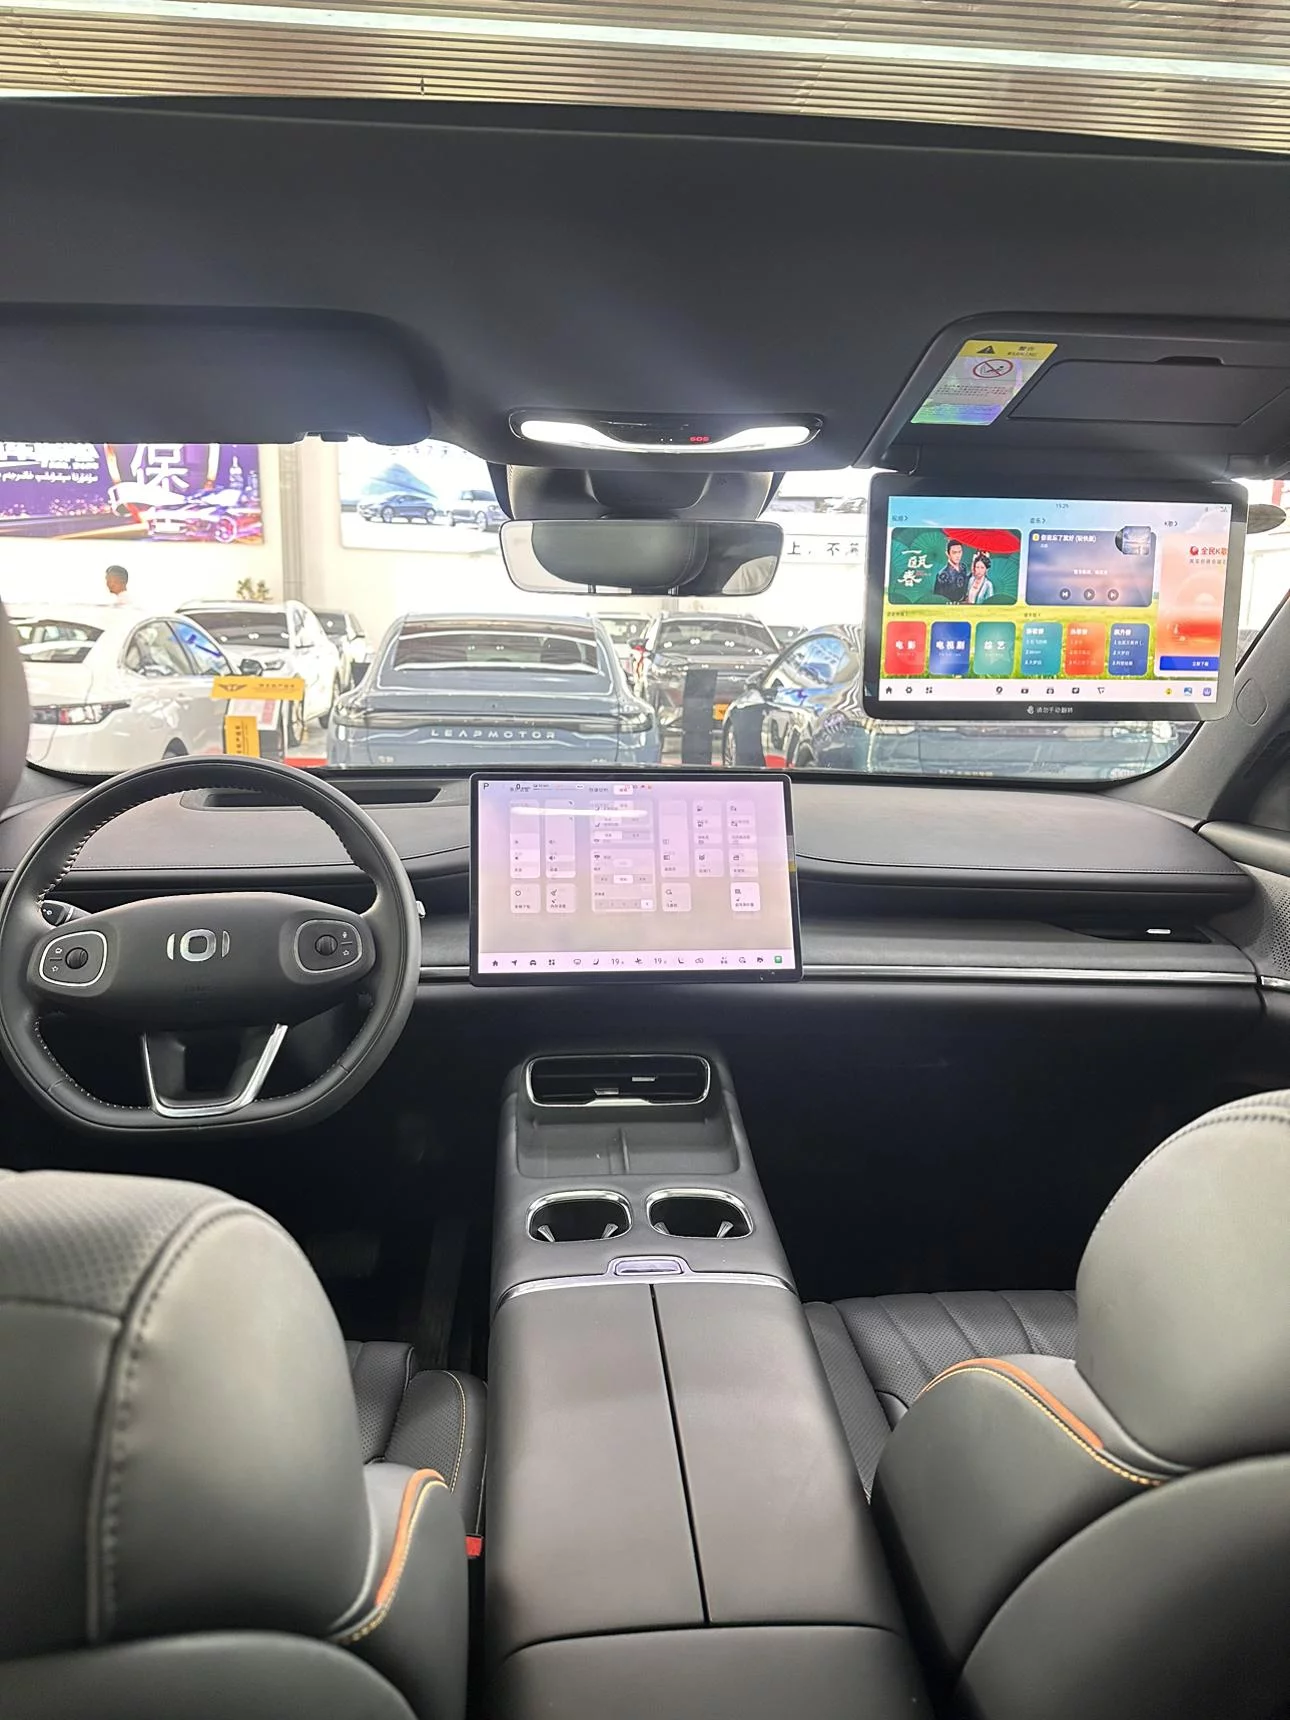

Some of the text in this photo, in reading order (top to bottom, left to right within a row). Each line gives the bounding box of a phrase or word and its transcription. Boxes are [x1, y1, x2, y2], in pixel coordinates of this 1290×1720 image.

[130, 443, 189, 489] 保
[1201, 545, 1228, 556] 全民K歌
[895, 640, 916, 650] 电影
[936, 640, 965, 650] 电视剧
[984, 640, 1006, 650] 综艺
[431, 729, 555, 739] LEAPMOTOR
